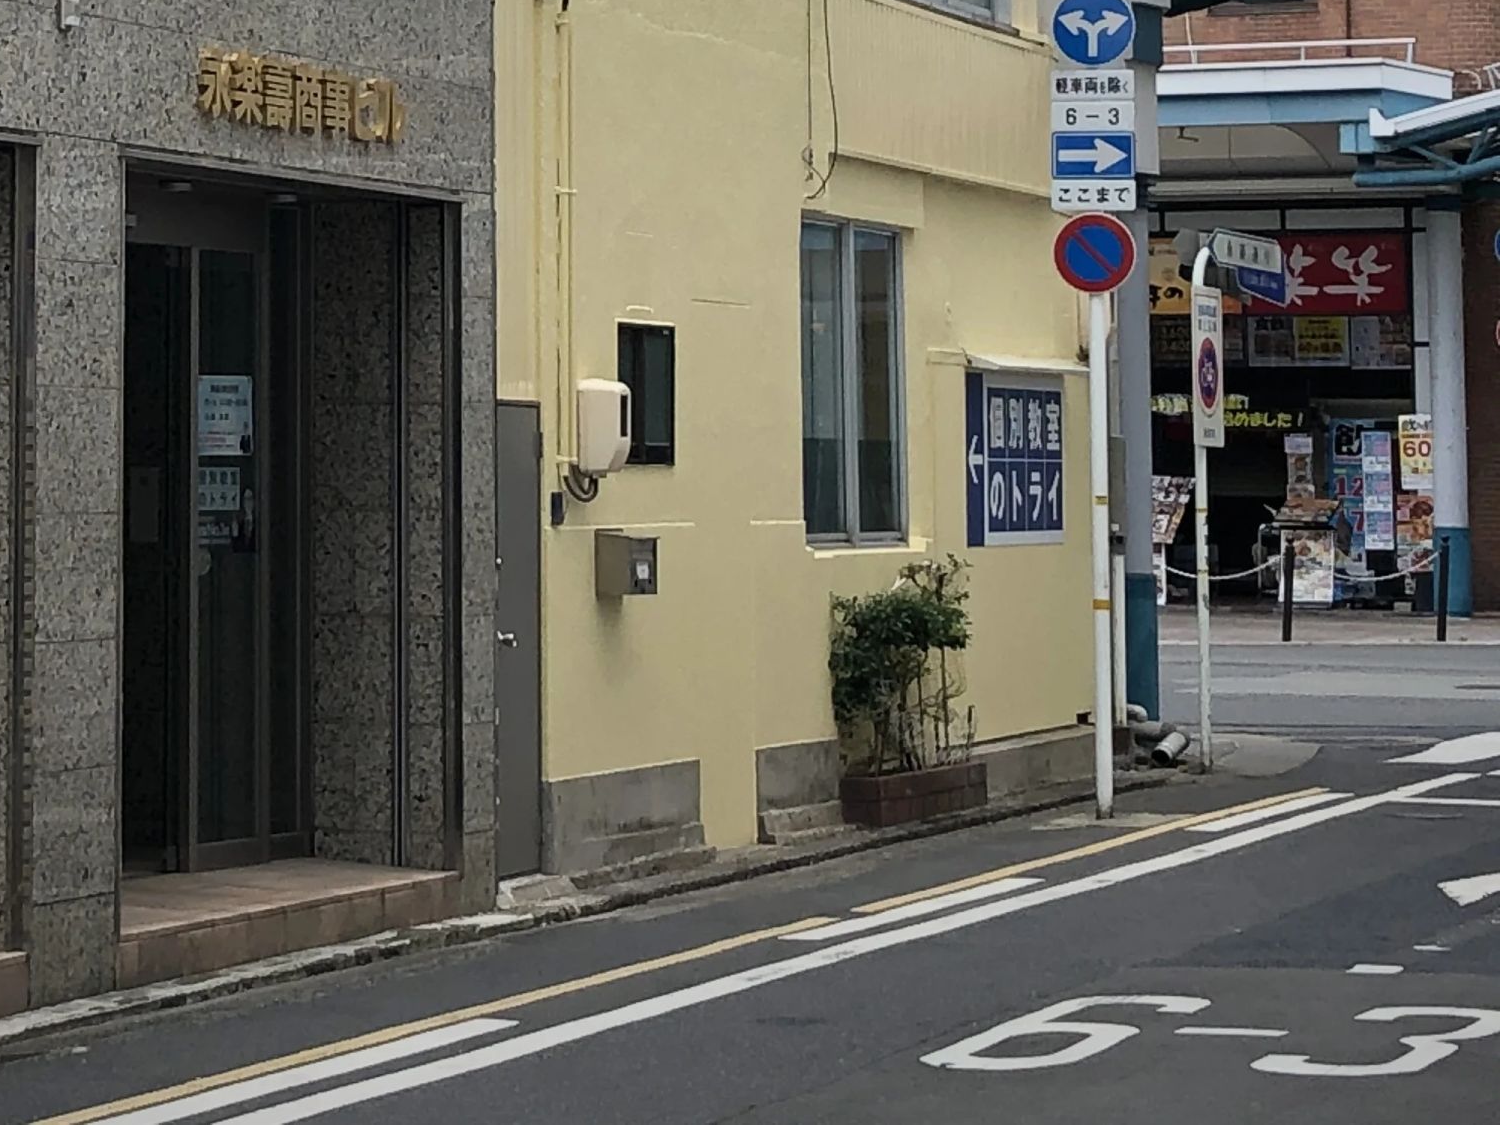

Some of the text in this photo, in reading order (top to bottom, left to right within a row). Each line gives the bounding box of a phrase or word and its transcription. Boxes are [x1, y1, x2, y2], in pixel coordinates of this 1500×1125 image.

[1056, 77, 1129, 95] 軽車両を除く
[1058, 187, 1130, 203] ここまで
[990, 396, 1061, 452] 個別教室
[989, 470, 1061, 522] のトライ
